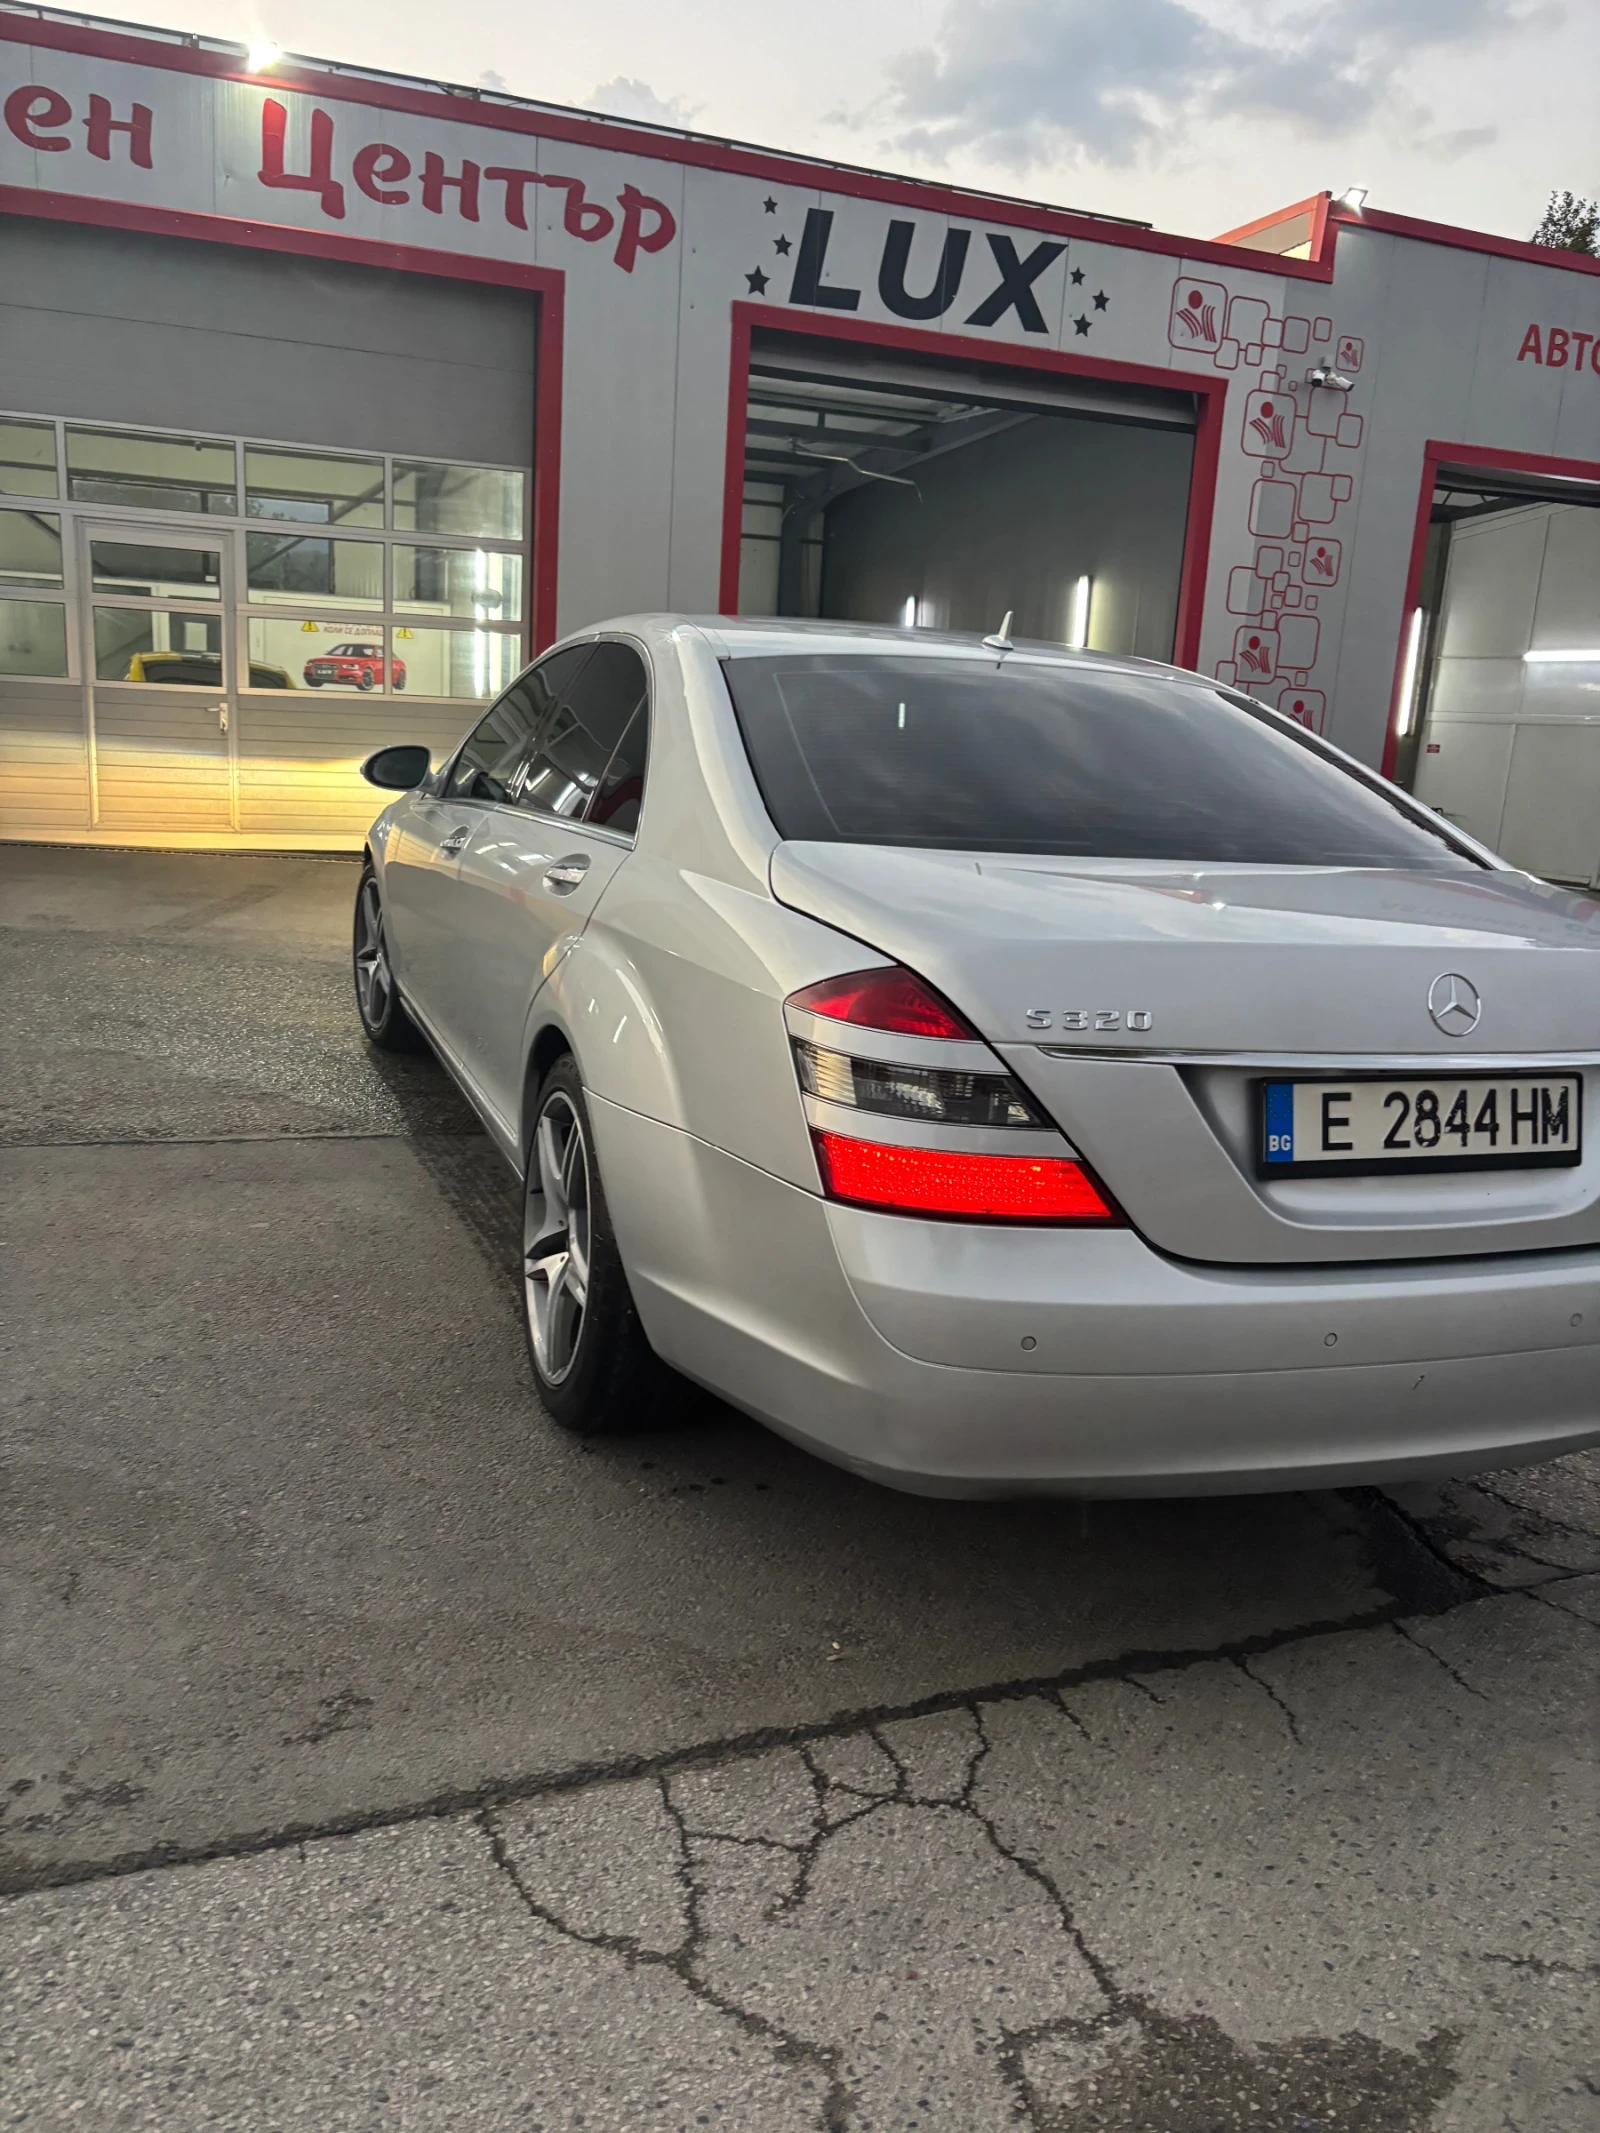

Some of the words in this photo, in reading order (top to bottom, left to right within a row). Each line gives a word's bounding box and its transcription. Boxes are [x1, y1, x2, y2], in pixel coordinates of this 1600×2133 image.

[257, 97, 676, 273] Център
[788, 207, 1068, 334] LUX
[1026, 1008, 1052, 1029] S
[1062, 1009, 1153, 1031] 320
[1268, 1134, 1292, 1152] BG
[1321, 1092, 1353, 1151] E
